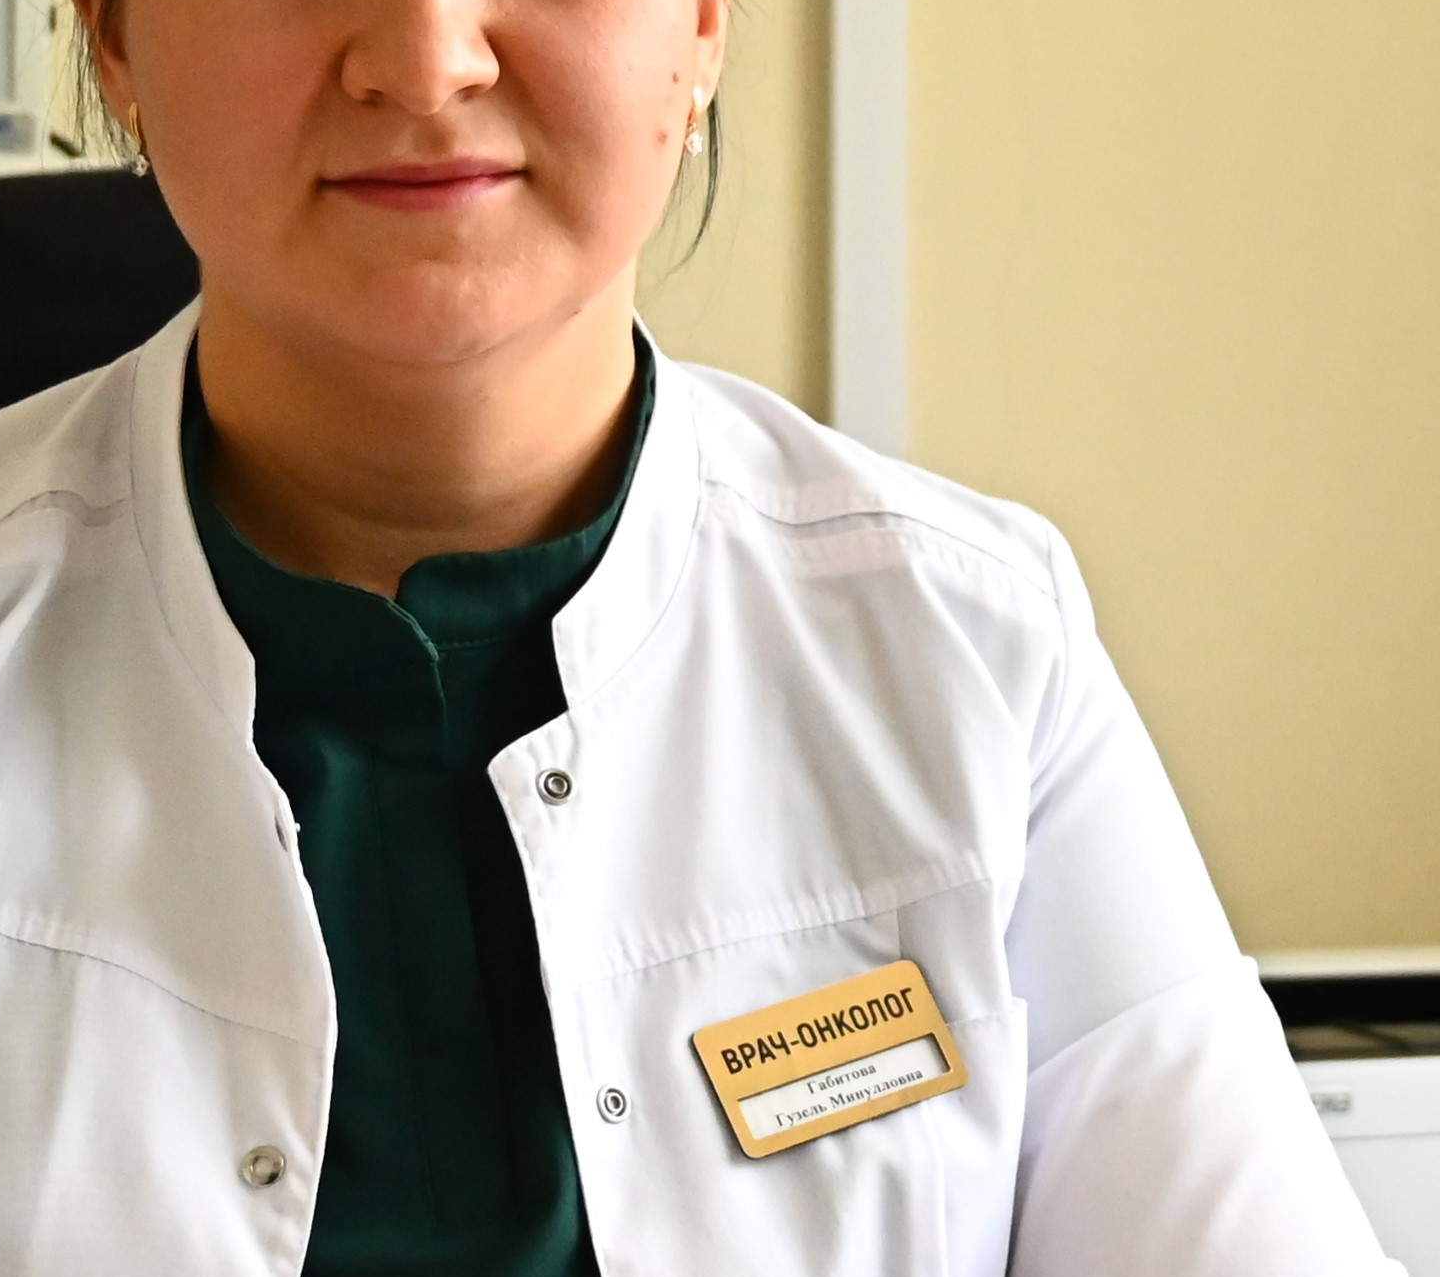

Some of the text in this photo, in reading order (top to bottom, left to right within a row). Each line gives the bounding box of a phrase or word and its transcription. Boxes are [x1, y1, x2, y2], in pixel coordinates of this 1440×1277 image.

[720, 987, 915, 1075] ВРАЧ-ОНКОЛОГ
[775, 1069, 924, 1127] Гузель Минулловна
[807, 1063, 877, 1095] Габитова
